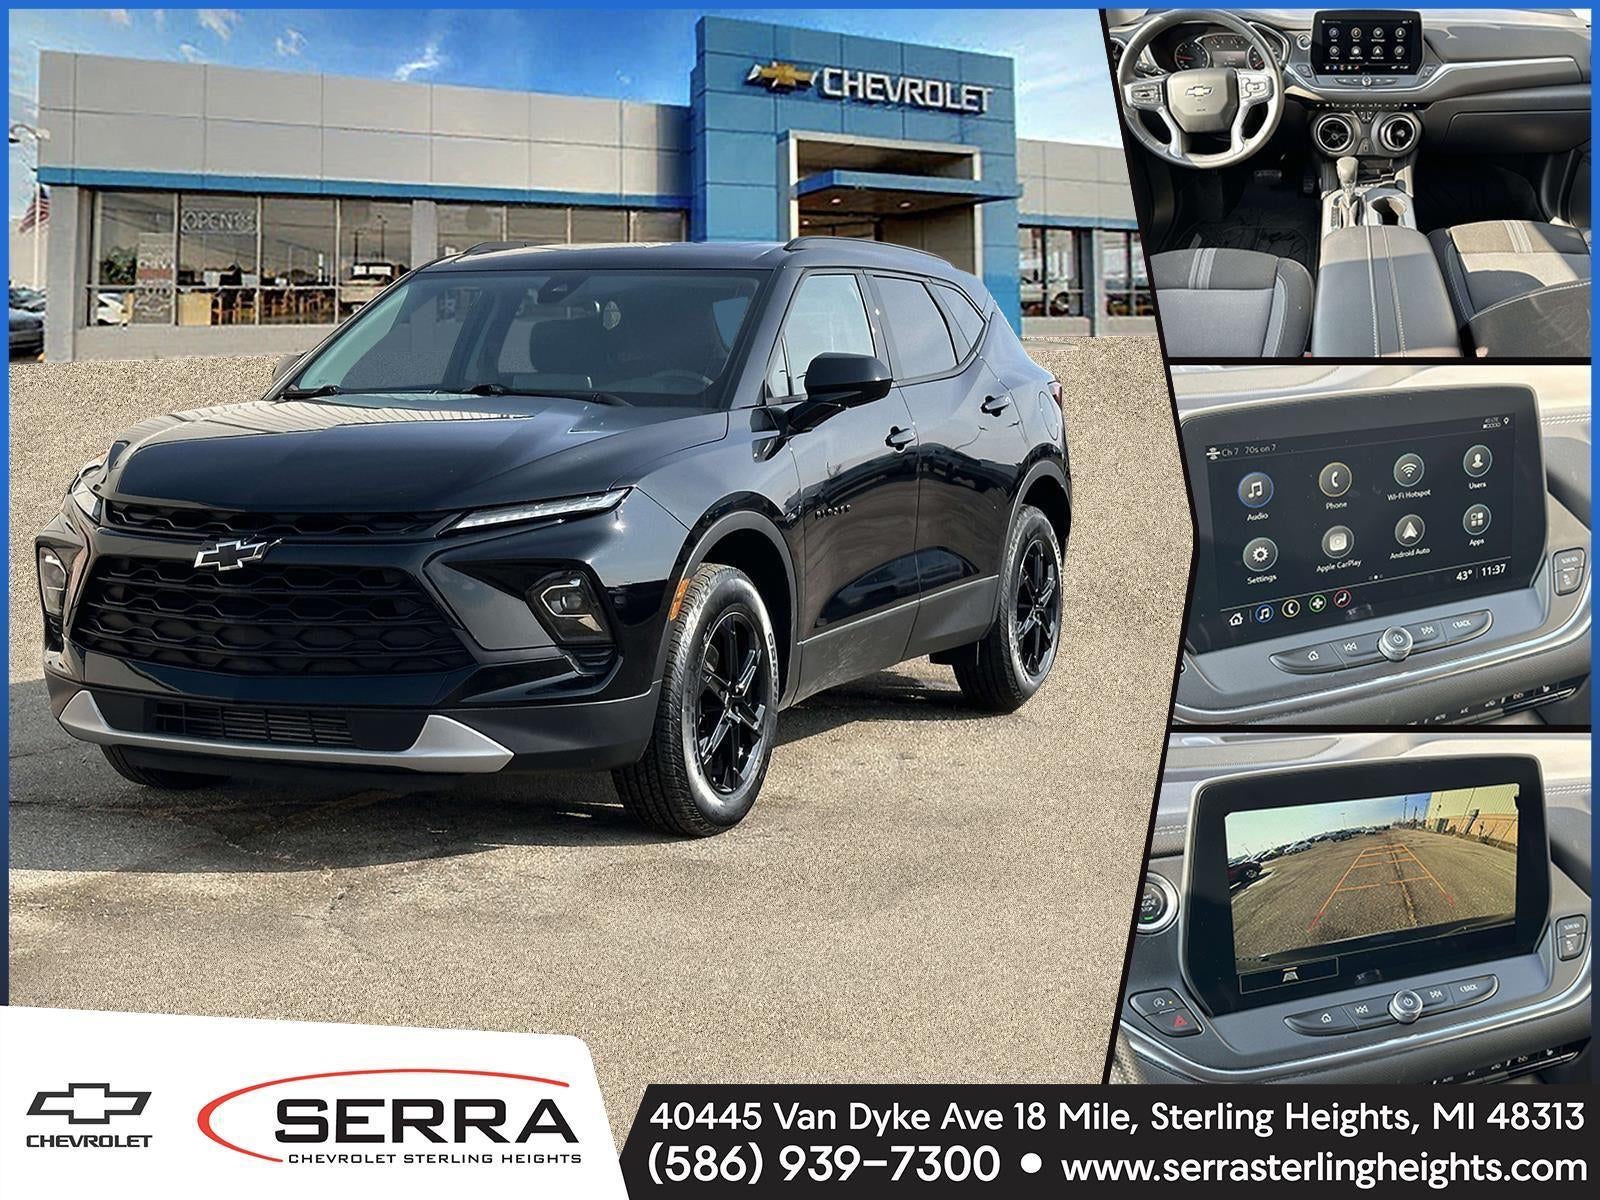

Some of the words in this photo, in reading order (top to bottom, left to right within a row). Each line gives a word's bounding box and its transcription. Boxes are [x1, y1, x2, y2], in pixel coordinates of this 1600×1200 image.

[822, 67, 993, 112] CHEVROLET
[1468, 481, 1487, 489] Users
[1387, 492, 1405, 501] Wi-Fi
[1405, 489, 1432, 499] Hotspot
[1325, 502, 1348, 510] Phone
[1246, 512, 1269, 521] Audio
[1468, 538, 1485, 546] Apps
[1389, 549, 1415, 560] Android
[1415, 547, 1431, 556] Auto
[1316, 563, 1336, 573] Apple
[1336, 559, 1362, 569] CarPlay
[1481, 564, 1507, 577] 11:37
[1247, 573, 1277, 585] Settings
